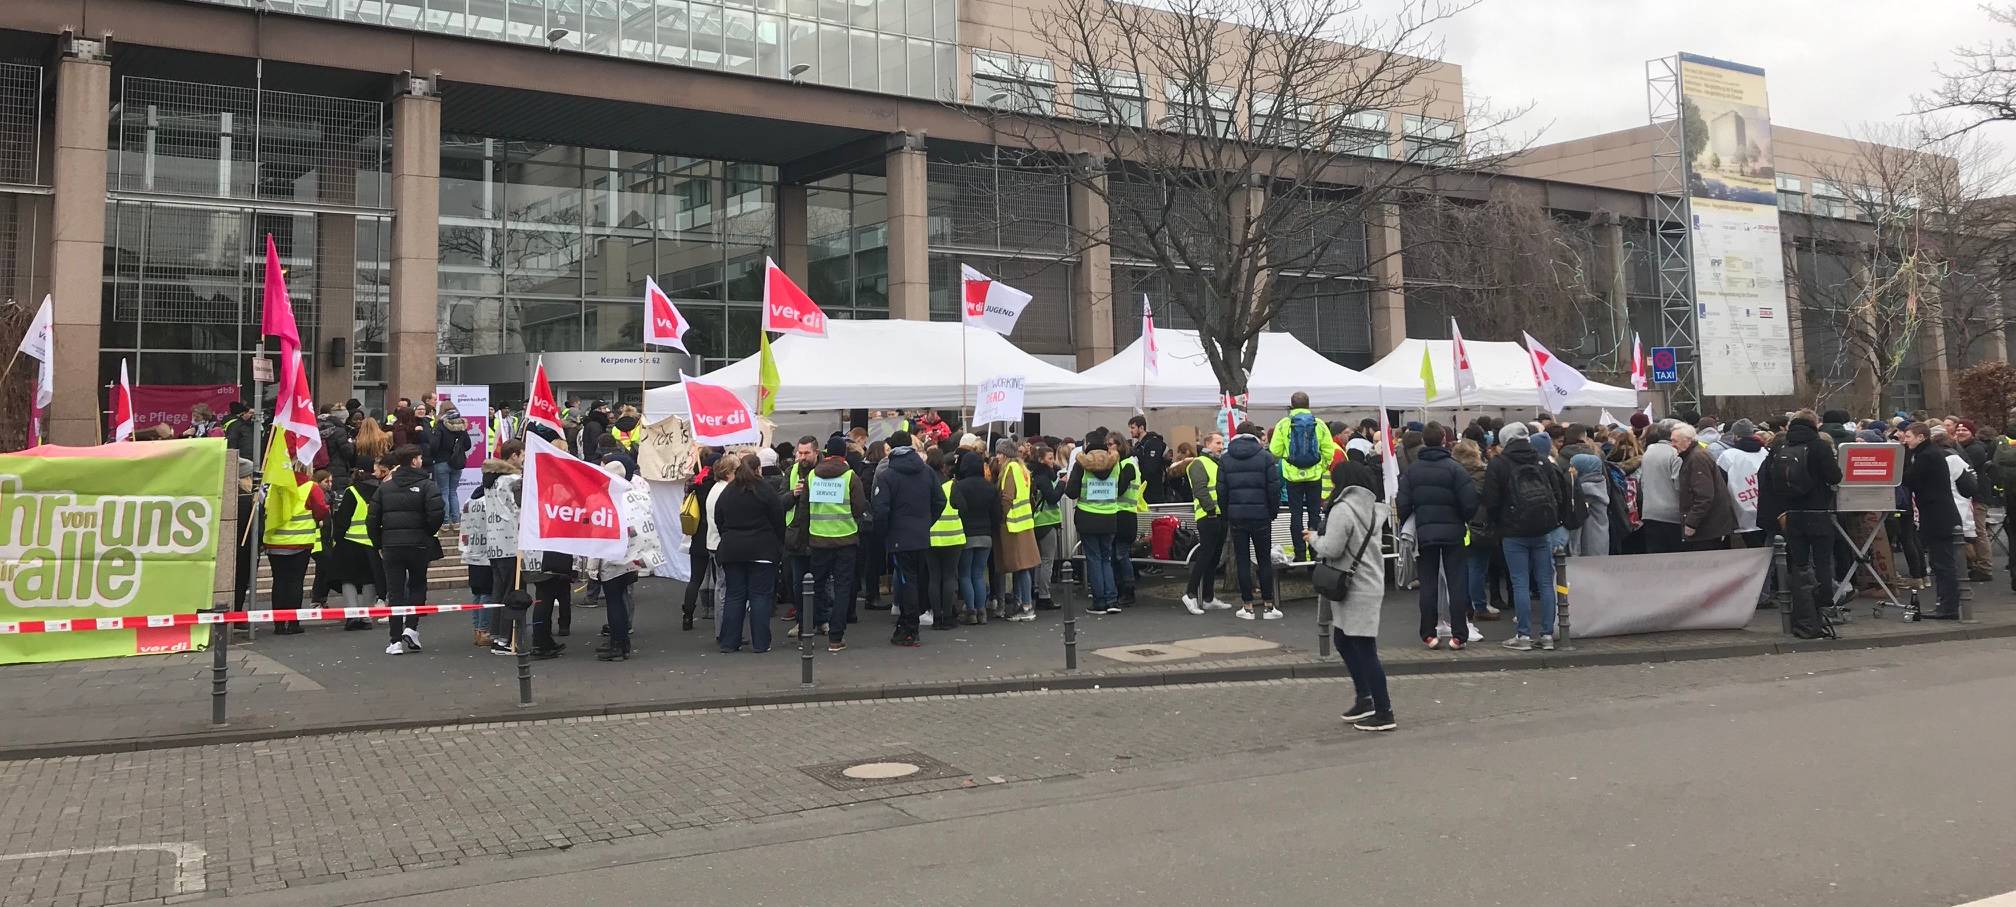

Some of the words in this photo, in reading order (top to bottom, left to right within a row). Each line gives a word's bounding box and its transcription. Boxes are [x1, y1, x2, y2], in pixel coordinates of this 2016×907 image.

[771, 304, 821, 328] ver.di
[986, 306, 1015, 317] JUGEND
[600, 356, 637, 365] Kerpener
[1655, 371, 1675, 380] TAXI
[217, 387, 235, 395] dbb
[150, 411, 189, 425] Pflege
[695, 410, 746, 427] ver.di
[544, 503, 614, 528] ver.di
[61, 510, 98, 529] von
[100, 499, 207, 548] uns
[470, 533, 487, 546] dbb
[486, 545, 504, 558] dbb
[13, 530, 137, 601] alle
